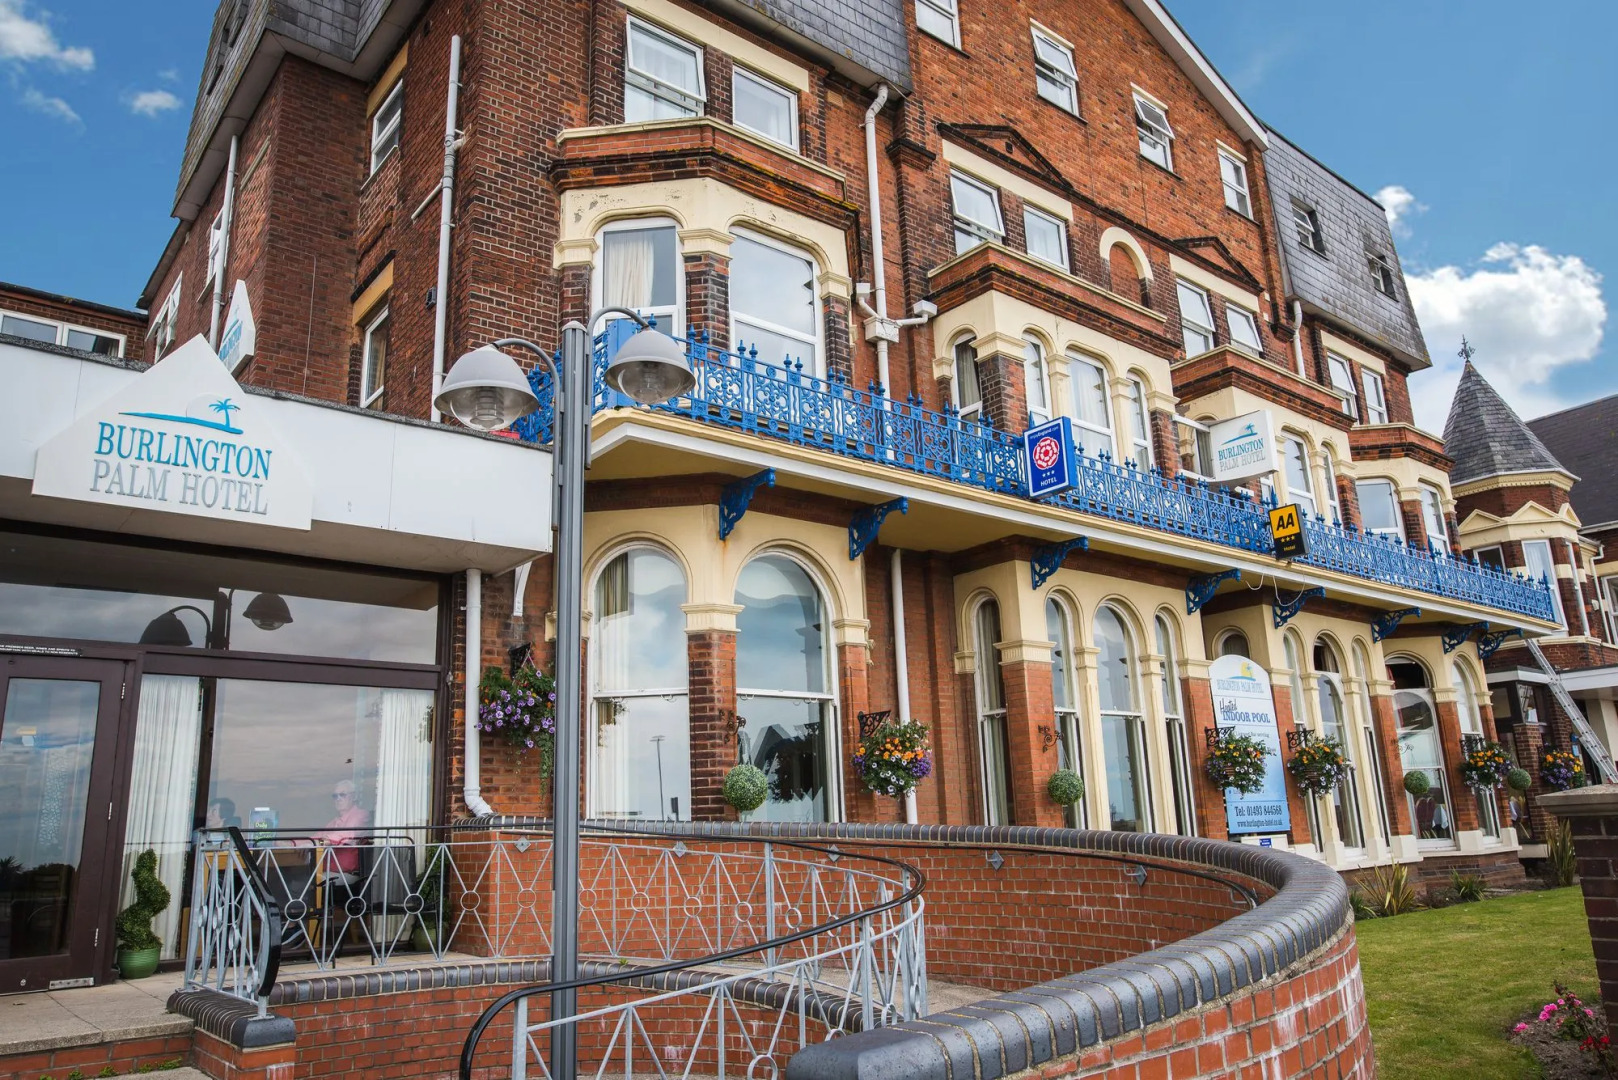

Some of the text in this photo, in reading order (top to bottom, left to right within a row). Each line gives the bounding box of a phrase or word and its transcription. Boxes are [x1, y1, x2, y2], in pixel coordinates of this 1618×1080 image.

[95, 421, 273, 481] BURLINGTON
[1218, 437, 1264, 461] BURLINGTON
[1219, 450, 1266, 472] PALM HOTEL
[89, 459, 268, 515] PALM HOTEL
[1040, 476, 1057, 487] HOTEL
[1276, 512, 1295, 531] AA
[1219, 697, 1237, 714] Heated
[1222, 711, 1271, 723] INDOOR POOL
[1234, 806, 1246, 817] Tel:
[1246, 805, 1263, 816] 01493
